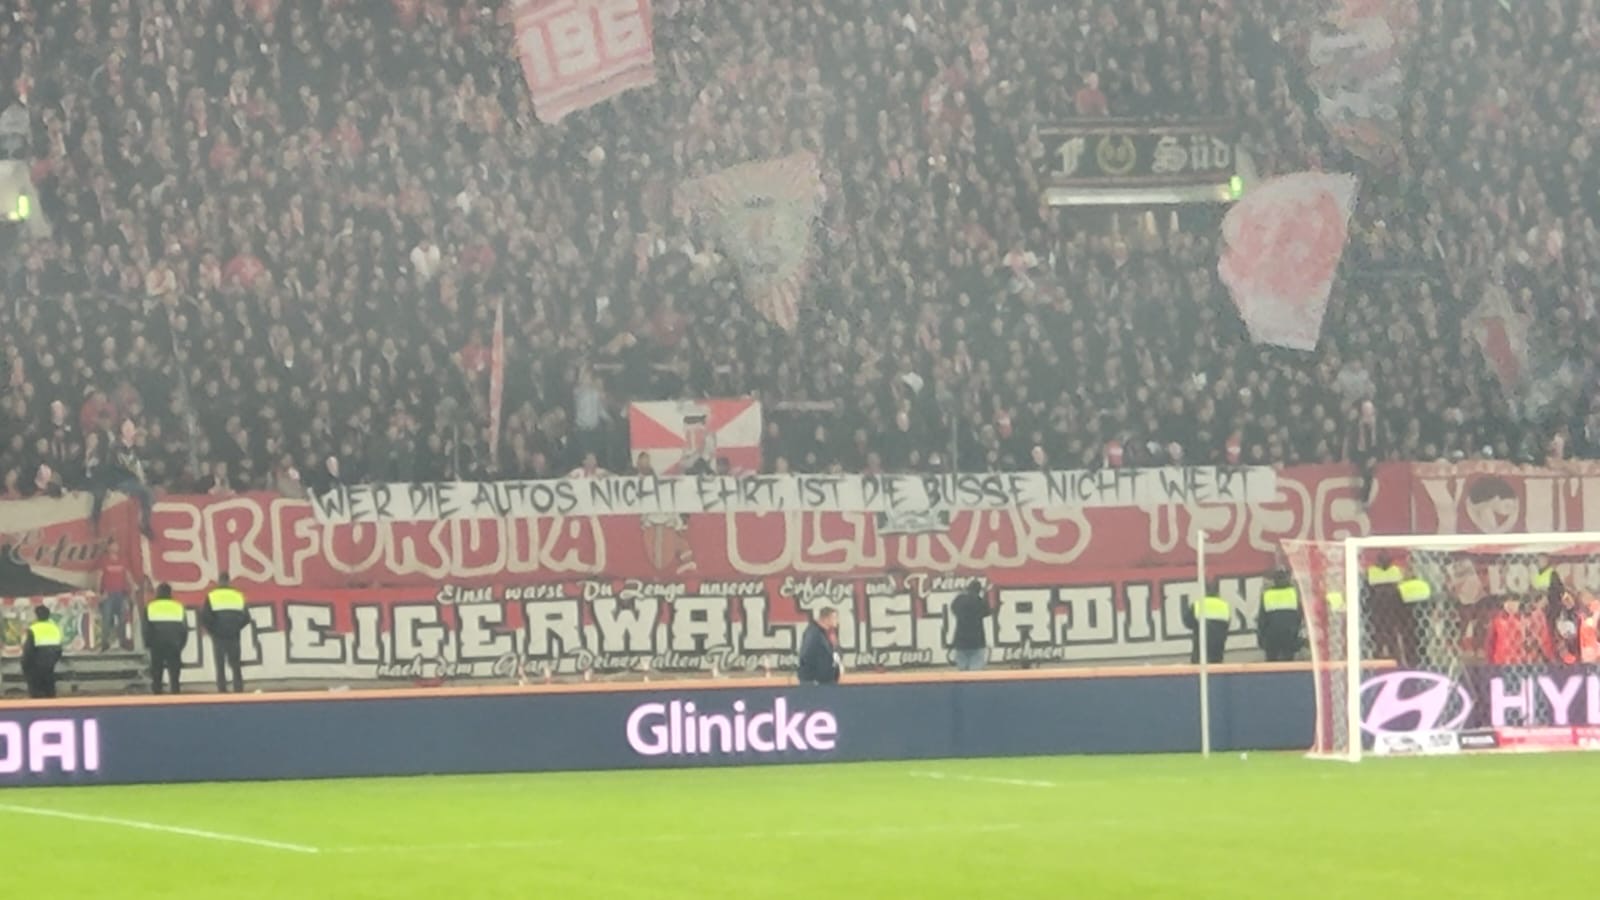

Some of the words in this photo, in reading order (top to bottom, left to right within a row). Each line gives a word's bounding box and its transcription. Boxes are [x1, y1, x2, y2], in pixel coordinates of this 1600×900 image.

[1152, 135, 1231, 173] Süd
[314, 482, 393, 520] WER
[408, 482, 460, 520] DIE
[471, 480, 578, 516] AUTOS
[590, 478, 677, 510] NICHT
[697, 476, 784, 511] EHRT,
[797, 476, 840, 507] IST
[861, 472, 909, 508] DIE
[923, 472, 1032, 507] BUSSE
[1046, 468, 1144, 504] NICHT
[1159, 465, 1262, 501] WERT
[437, 585, 492, 603] Einst
[506, 583, 563, 600] warst
[578, 580, 613, 601] Du
[620, 579, 685, 601] Zeuge
[700, 581, 764, 597] unserer
[780, 576, 854, 603] Erfolge
[866, 575, 896, 596] und
[378, 655, 422, 677] nach
[436, 654, 474, 676] dem
[626, 697, 838, 755] Glinicke
